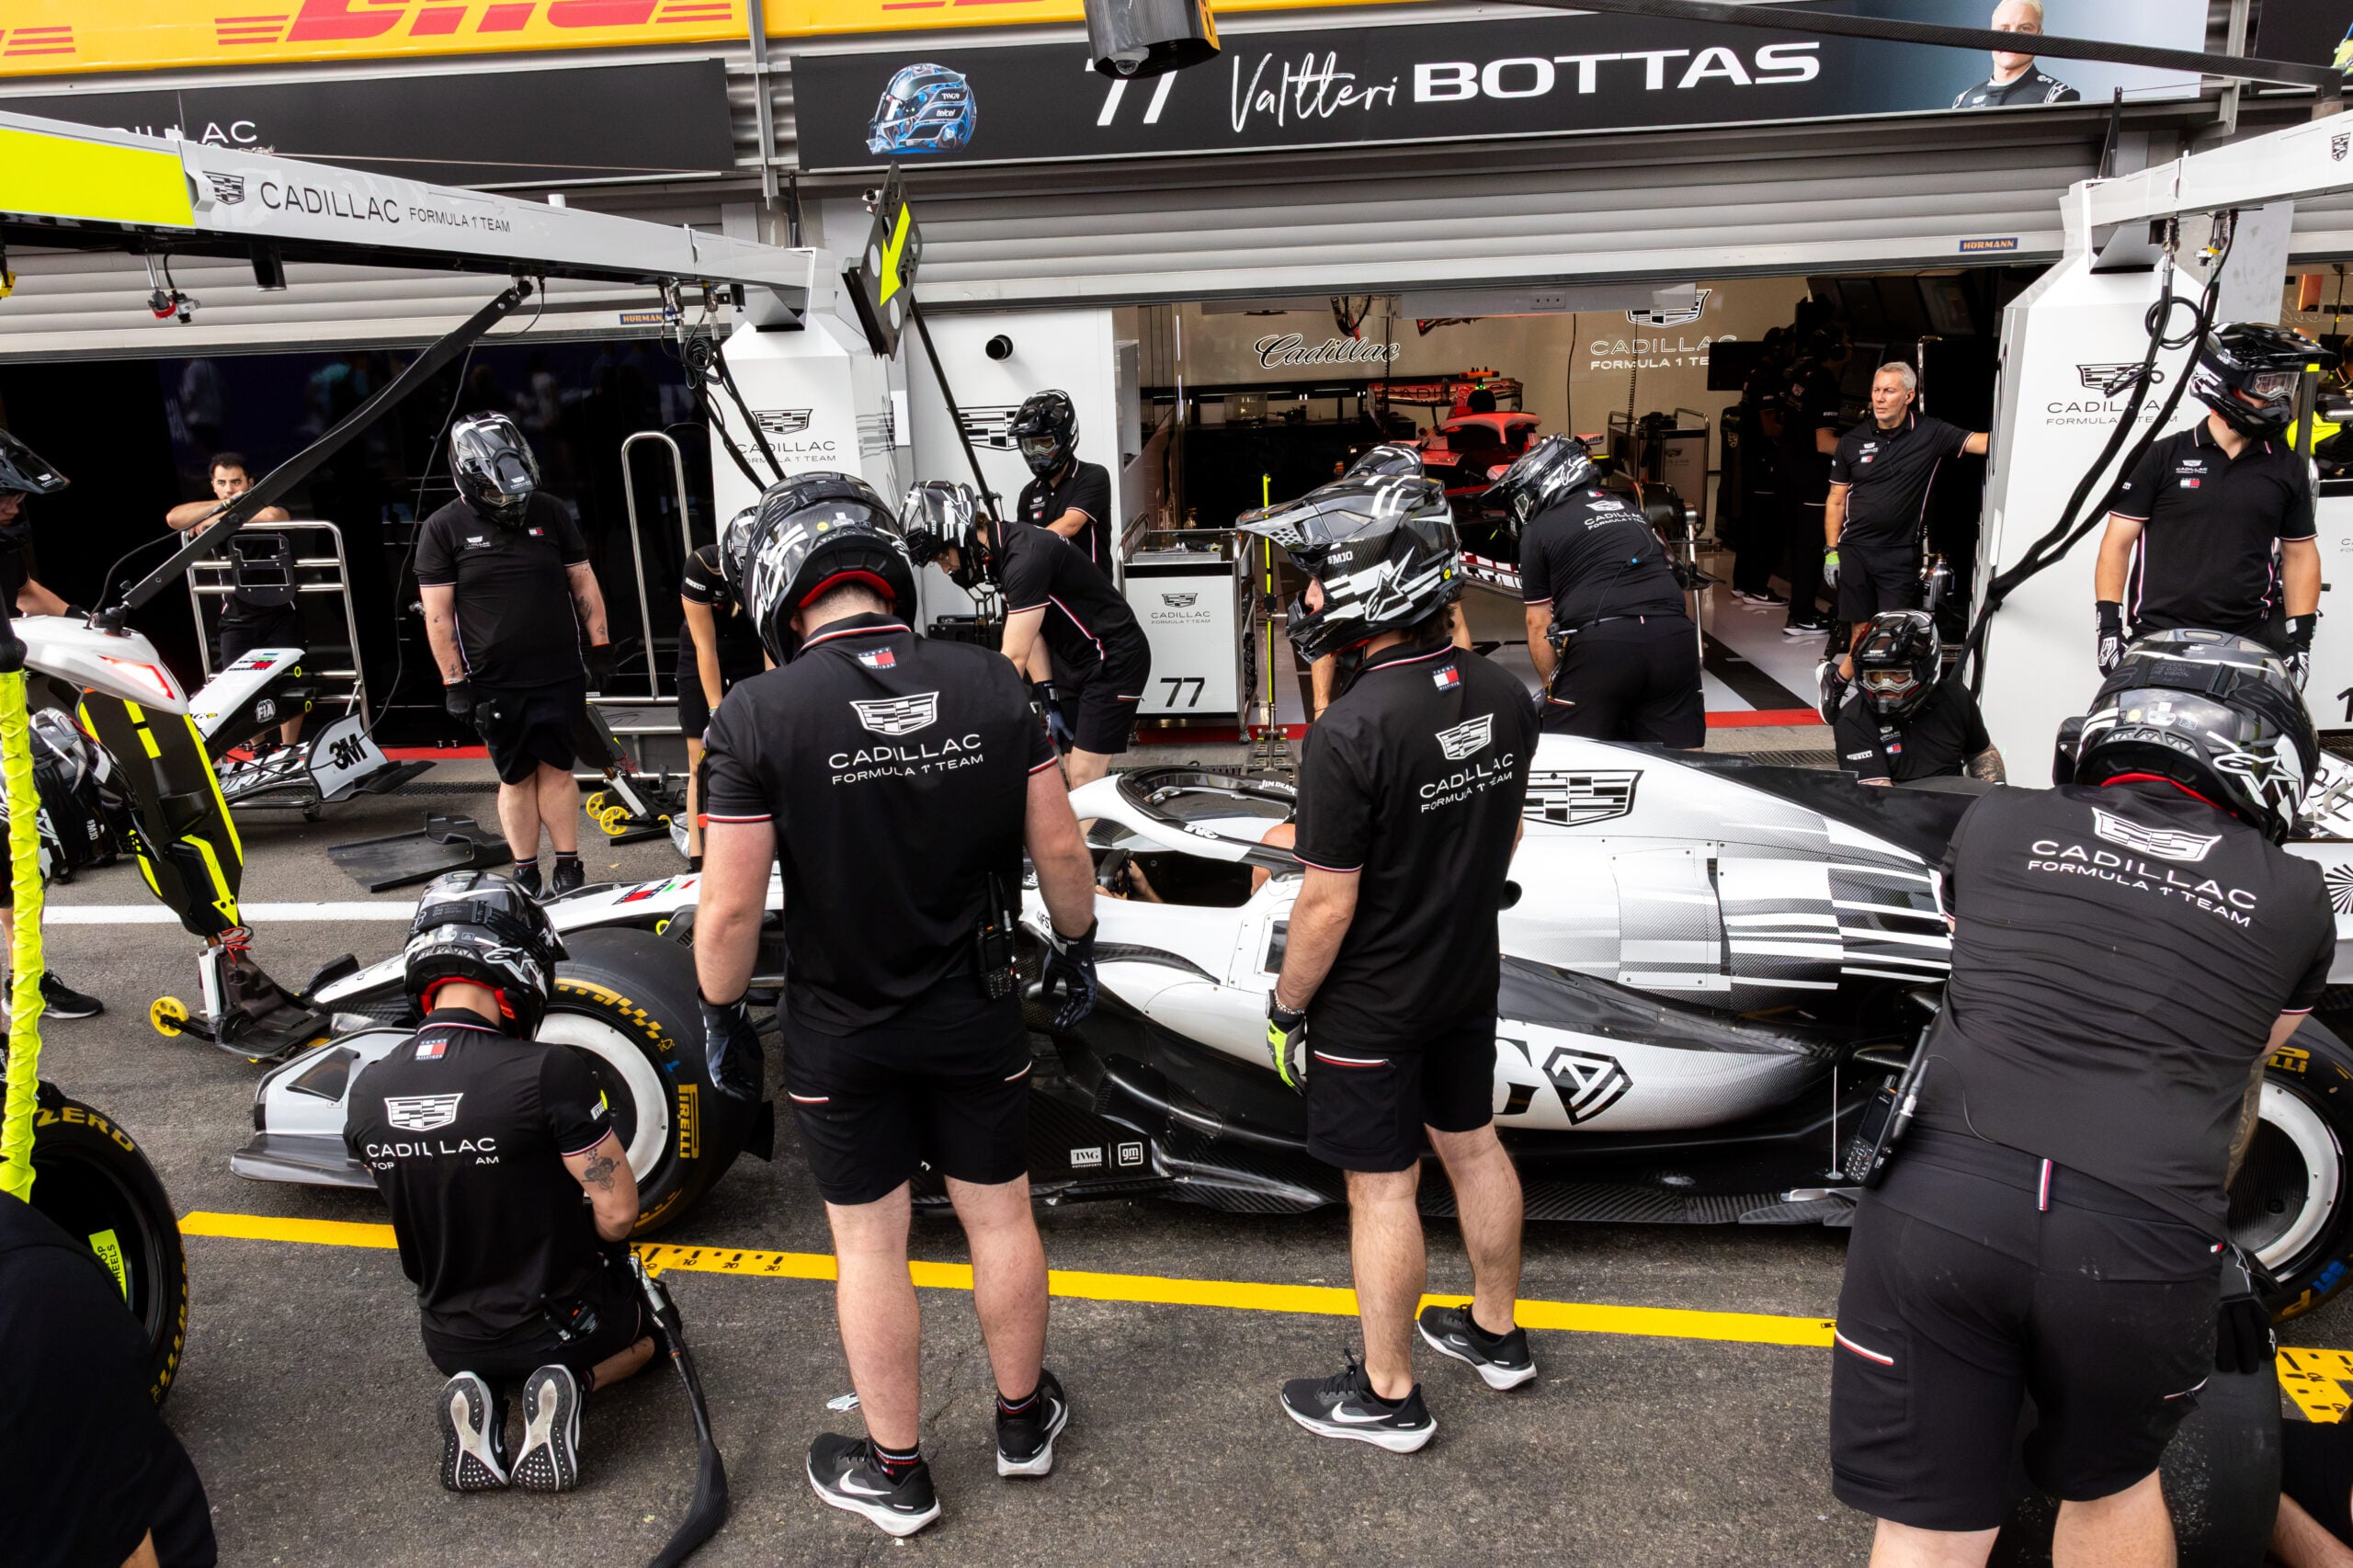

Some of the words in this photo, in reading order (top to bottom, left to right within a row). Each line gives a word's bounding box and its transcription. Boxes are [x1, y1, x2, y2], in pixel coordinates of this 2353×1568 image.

[1232, 51, 1397, 132] Valtteri
[1414, 41, 1820, 102] BOTTAS
[260, 181, 401, 223] CADILLAC
[409, 207, 470, 227] FORMULA
[481, 217, 511, 233] TEAM
[1254, 333, 1400, 369] Cadillac
[1590, 335, 1737, 356] CADILLA
[1590, 358, 1671, 369] FORMULA
[1689, 356, 1710, 366] TE
[2047, 400, 2179, 414] CADILA
[2136, 415, 2177, 424] TEM
[1160, 677, 1205, 708] 77
[256, 704, 274, 721] FIA
[329, 733, 368, 770] 3M
[828, 733, 982, 769] CADILLAC
[832, 765, 916, 786] FORMULA
[936, 755, 984, 772] TEAM
[1419, 753, 1514, 798] CADLLAC
[1489, 771, 1513, 786] EAM
[1259, 779, 1274, 790] JIM
[1275, 781, 1298, 795] BEAM
[2031, 839, 2256, 910] CADILLAC
[2028, 860, 2148, 890] FORMULA
[2176, 891, 2251, 926] TEAM
[37, 1107, 134, 1152] ZERO
[677, 1084, 699, 1158] PIRELLI
[366, 1138, 497, 1157] CADILLAC
[1073, 1150, 1098, 1161] TWG
[1122, 1148, 1139, 1161] gm
